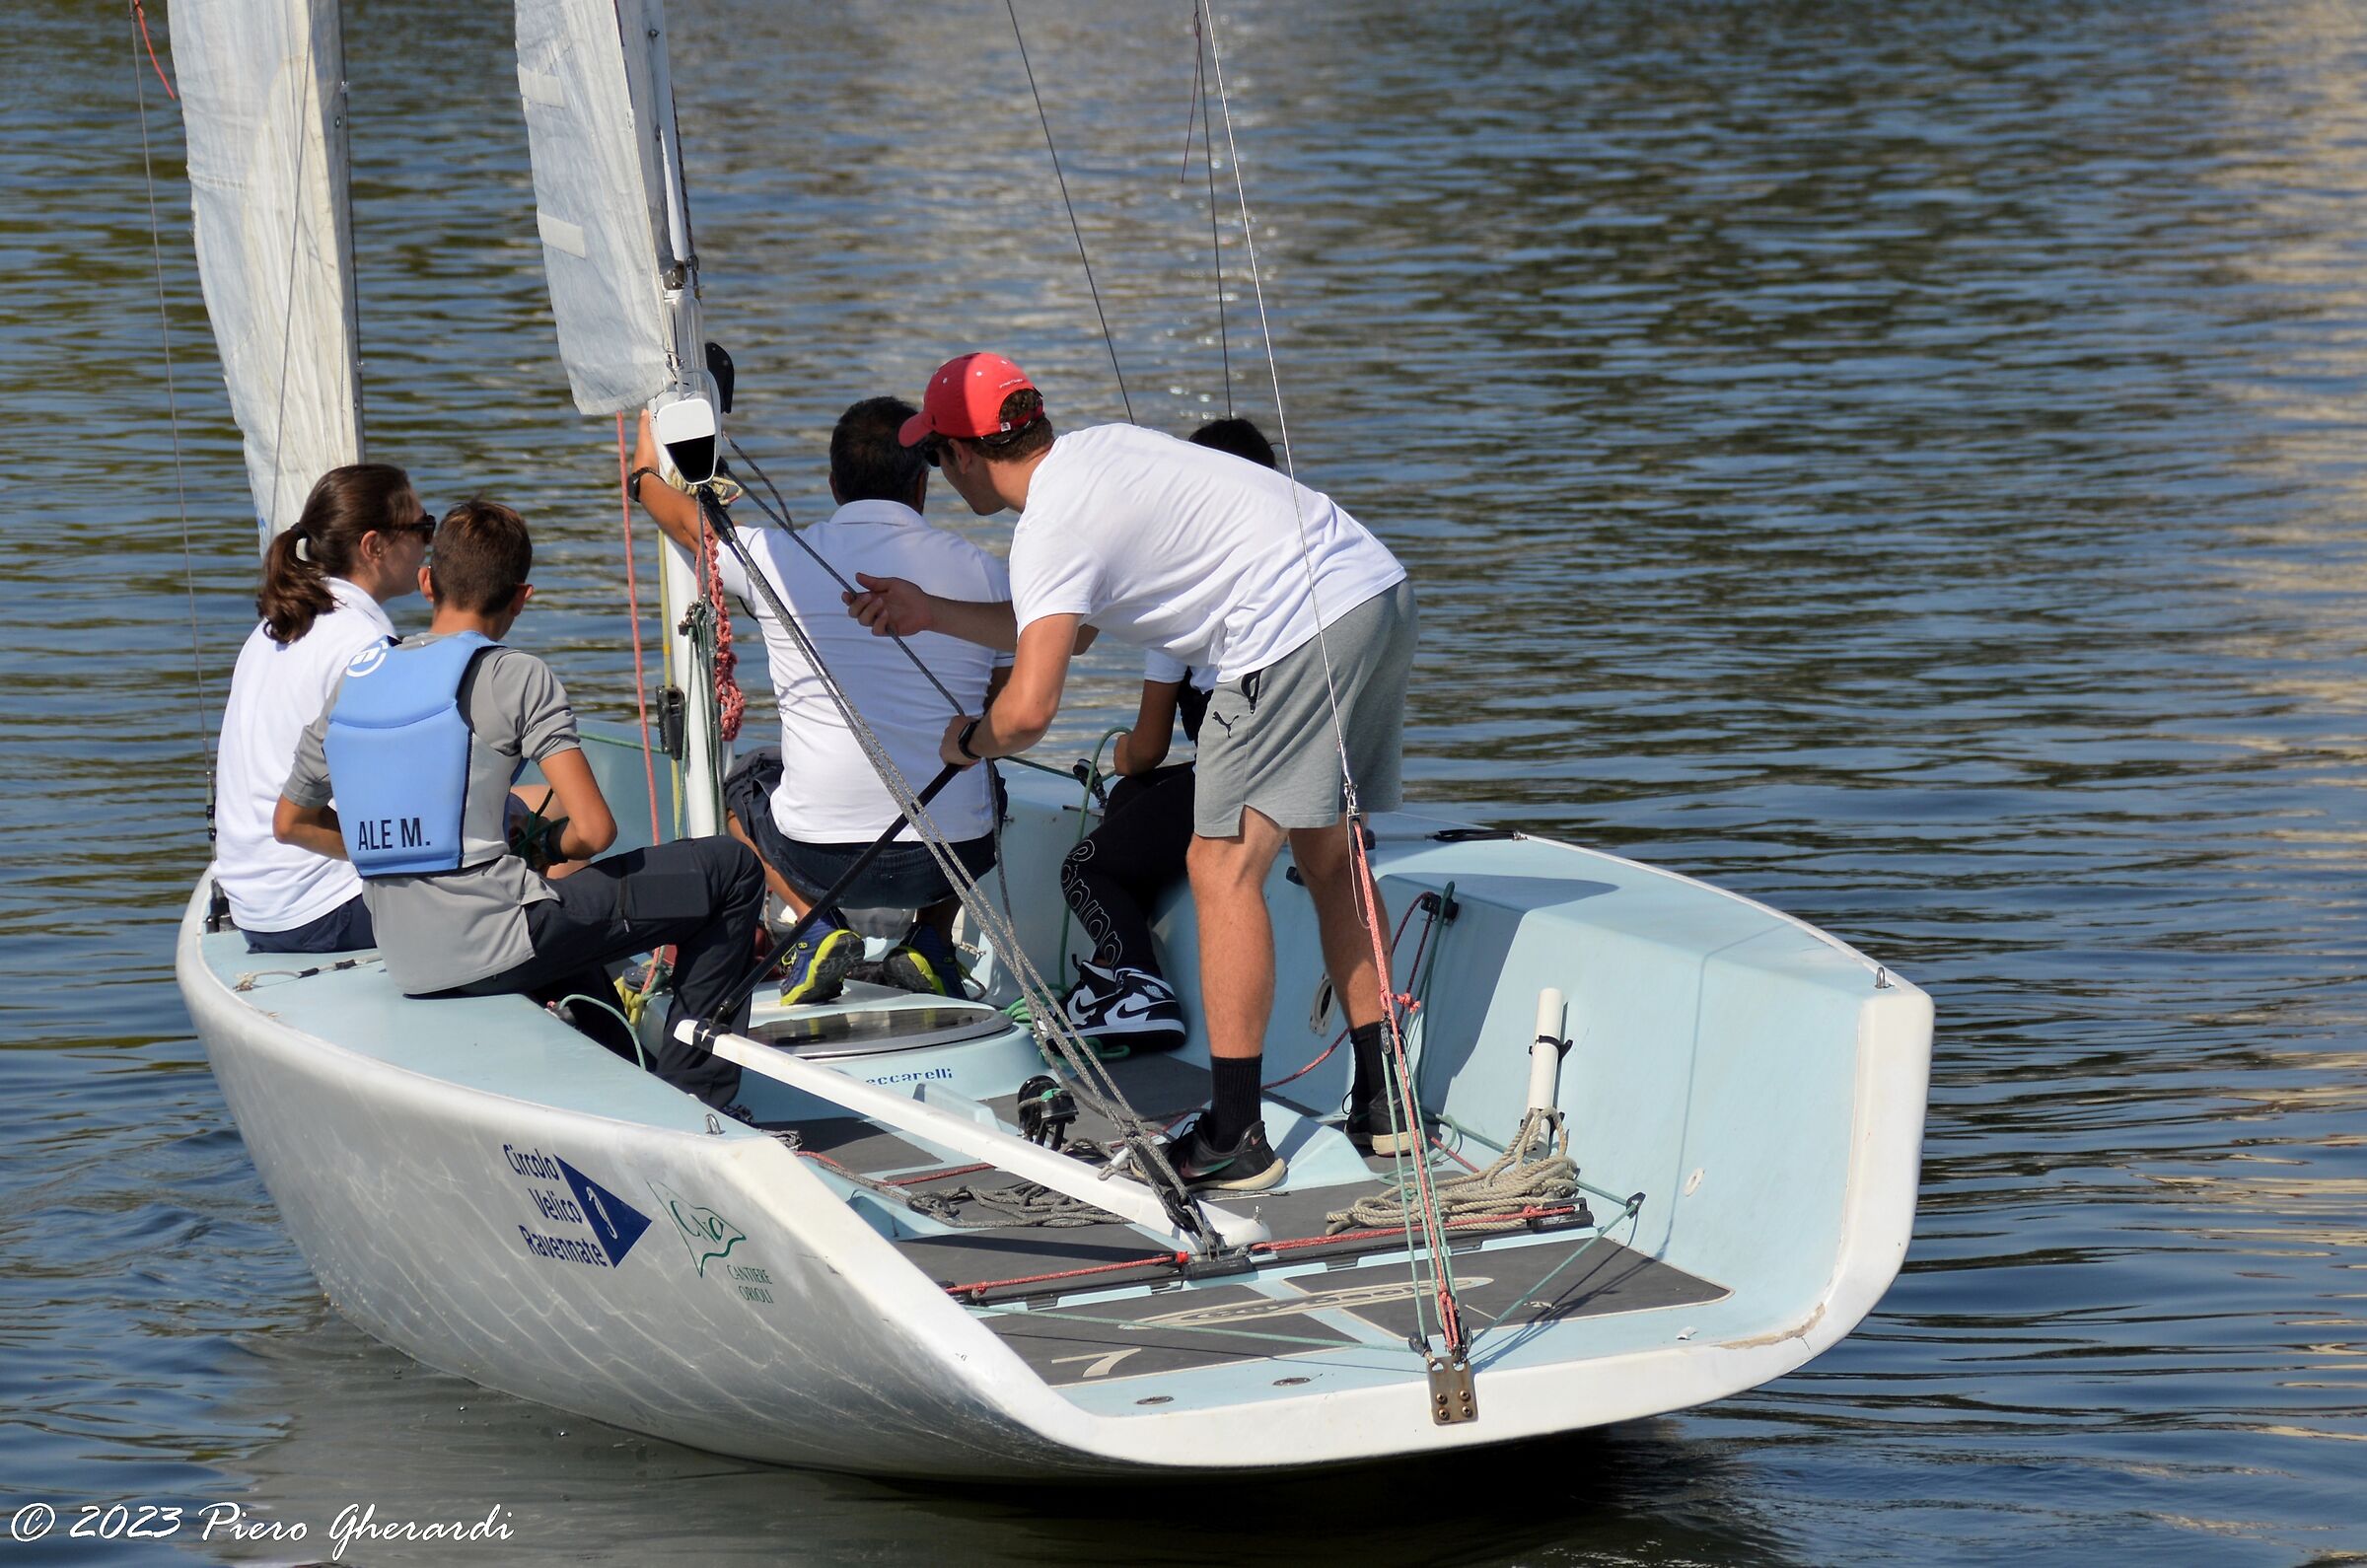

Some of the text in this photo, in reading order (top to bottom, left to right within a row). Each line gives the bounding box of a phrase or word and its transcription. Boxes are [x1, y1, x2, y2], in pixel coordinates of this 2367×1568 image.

[358, 817, 431, 850] ALE M.
[502, 1144, 560, 1180] Circolo
[528, 1187, 583, 1224] Velico
[518, 1224, 608, 1267] Ravennate
[726, 1264, 773, 1285] CANTIERE
[738, 1285, 774, 1304] ORIOLI
